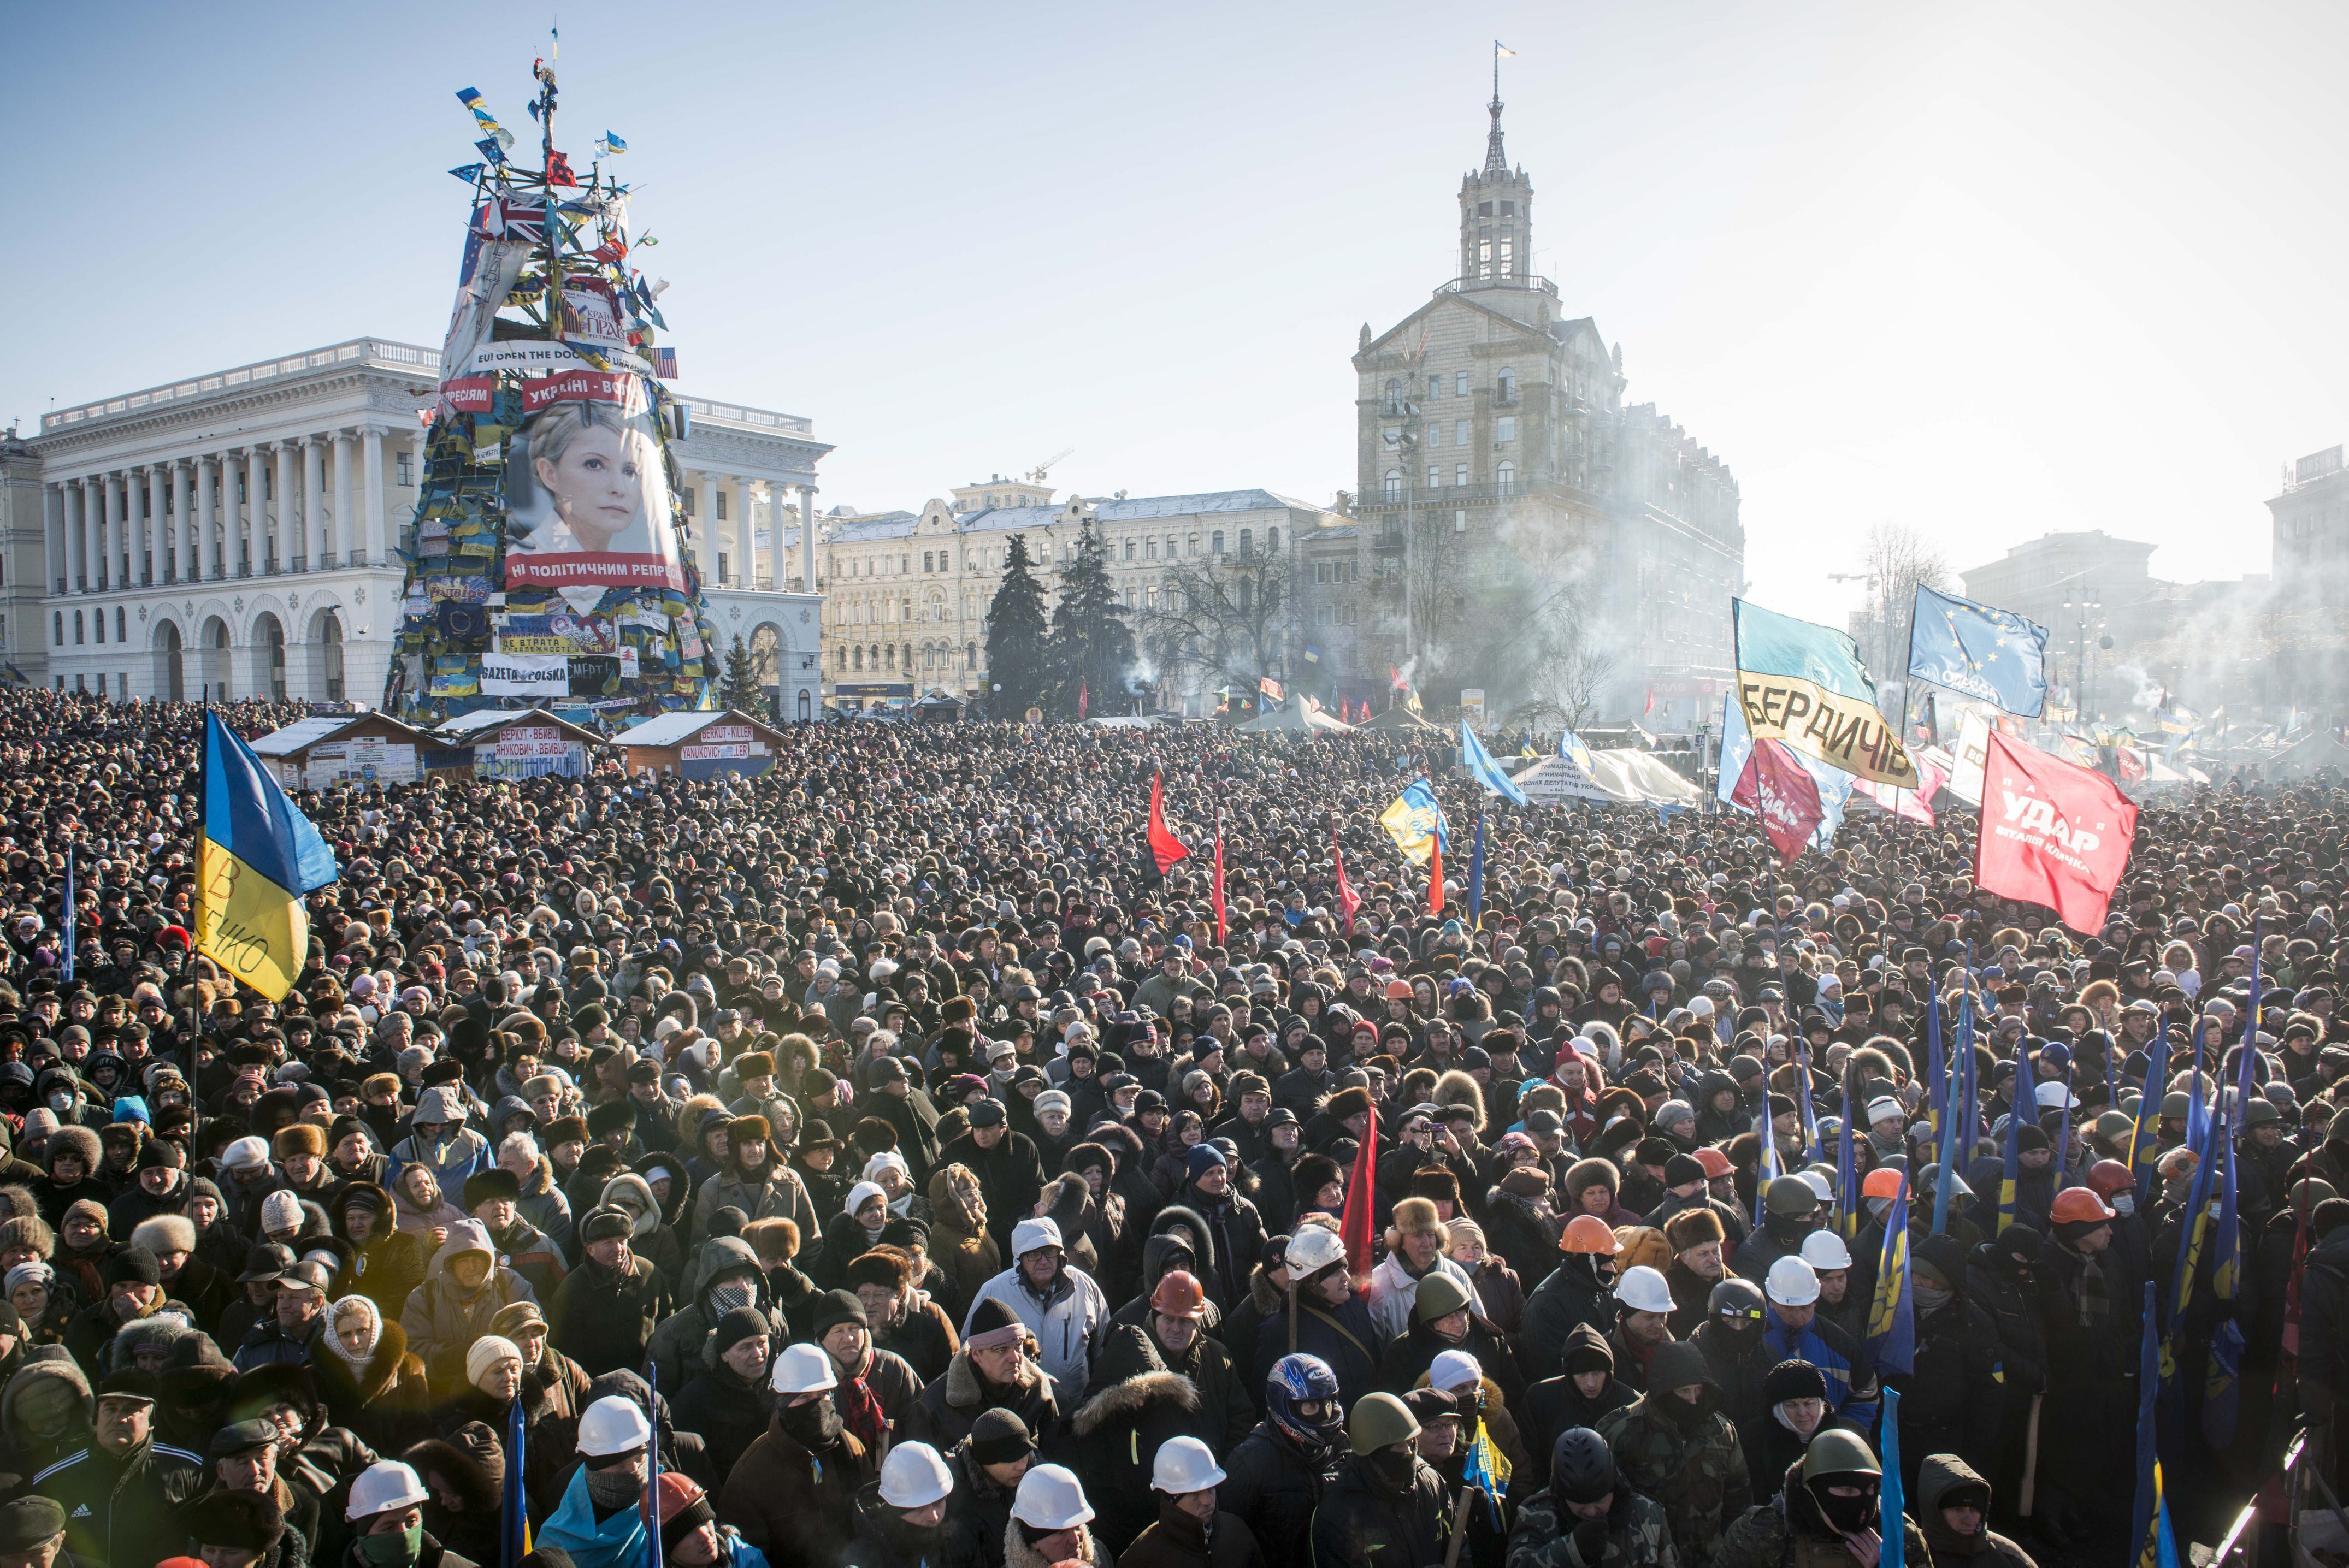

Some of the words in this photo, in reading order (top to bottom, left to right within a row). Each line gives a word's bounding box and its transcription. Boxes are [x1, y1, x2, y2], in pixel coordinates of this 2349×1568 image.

[588, 310, 615, 322] КРАЇН
[479, 351, 493, 363] EU!
[496, 351, 526, 361] OPEN
[529, 351, 551, 359] THE
[436, 389, 487, 404] РПРЕСІЯМ
[529, 379, 588, 403] УКРАЇНІ
[512, 563, 525, 577] НІ
[530, 563, 627, 577] ПОЛІТИЧНИМ
[482, 667, 518, 681] GAZETA
[528, 668, 566, 681] POLSKA
[501, 729, 528, 741] БЕРКУТ
[534, 727, 559, 741] ВБИВЦІ
[703, 727, 726, 739] BERKUT
[731, 726, 752, 738] KILLER
[496, 744, 533, 756] ЯНУКОВИЧ
[540, 743, 567, 755] ВБИВЦЯ
[1538, 772, 1581, 780] ПРИЙМАЛЬНЯ
[1544, 779, 1579, 788] ДЕПУТАТІВ
[2002, 790, 2100, 854] УДАР
[1996, 825, 2044, 847] ВІТАЛІЯ
